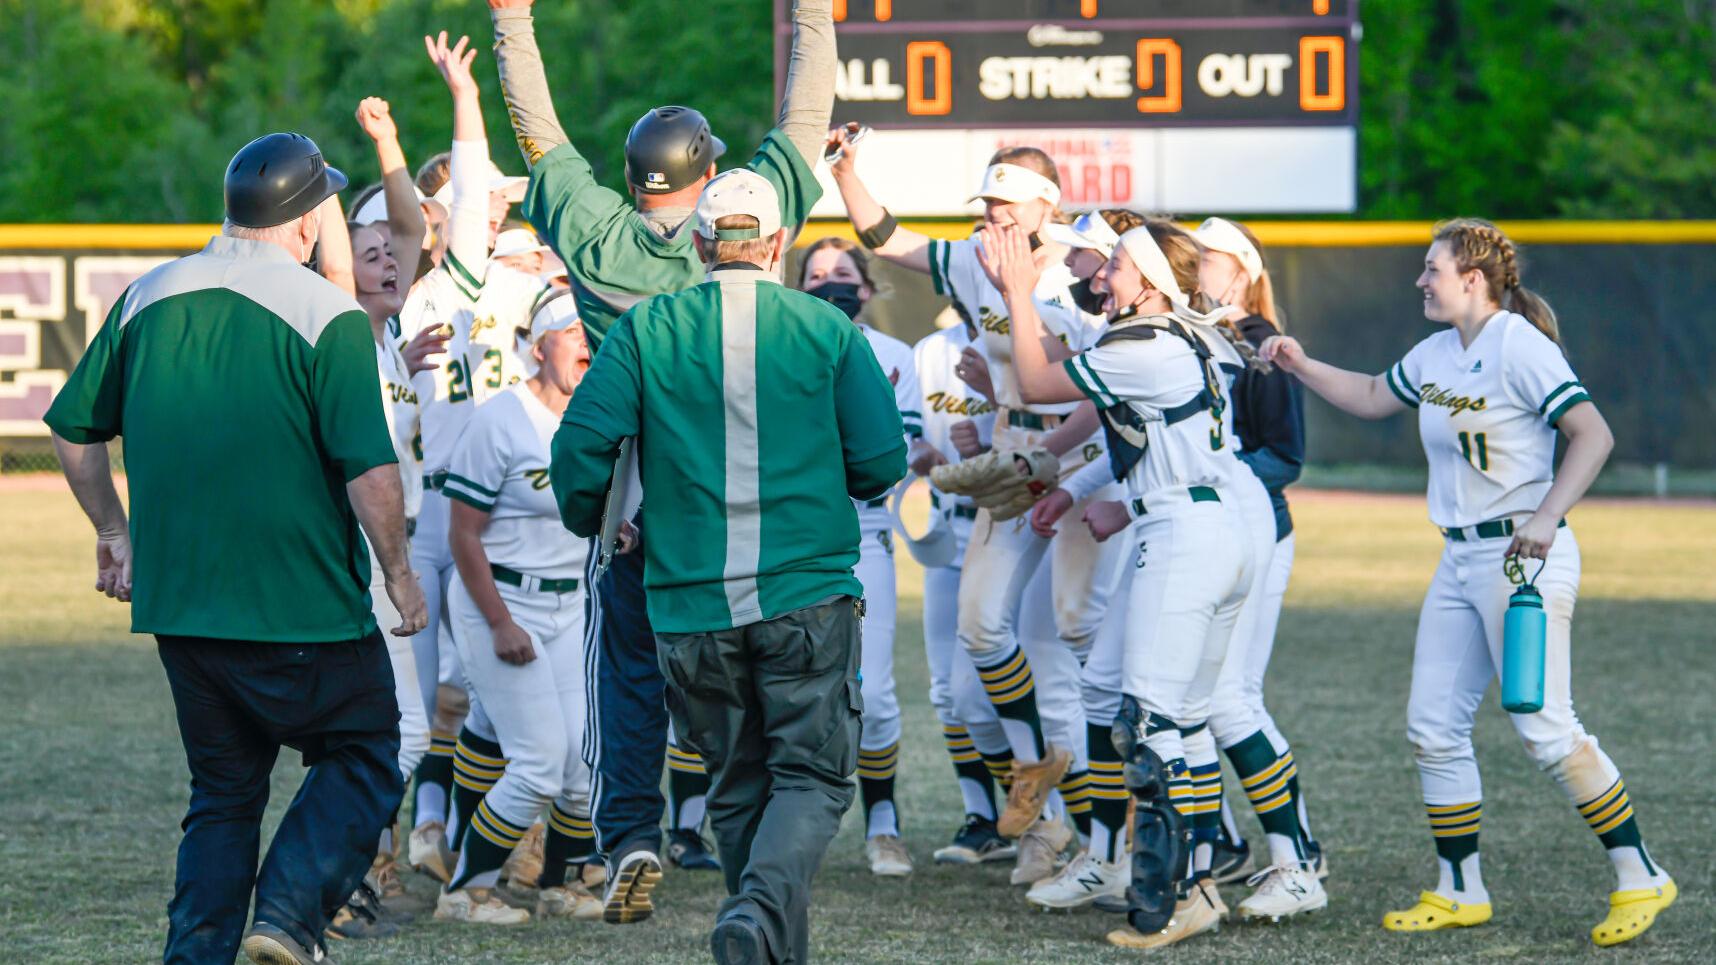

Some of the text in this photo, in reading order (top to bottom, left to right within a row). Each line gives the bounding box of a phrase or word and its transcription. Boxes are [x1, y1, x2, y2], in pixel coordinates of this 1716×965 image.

[979, 56, 1133, 99] STRIKE
[1198, 54, 1292, 97] OUT
[1299, 36, 1345, 111] 0
[1458, 431, 1488, 472] 11
